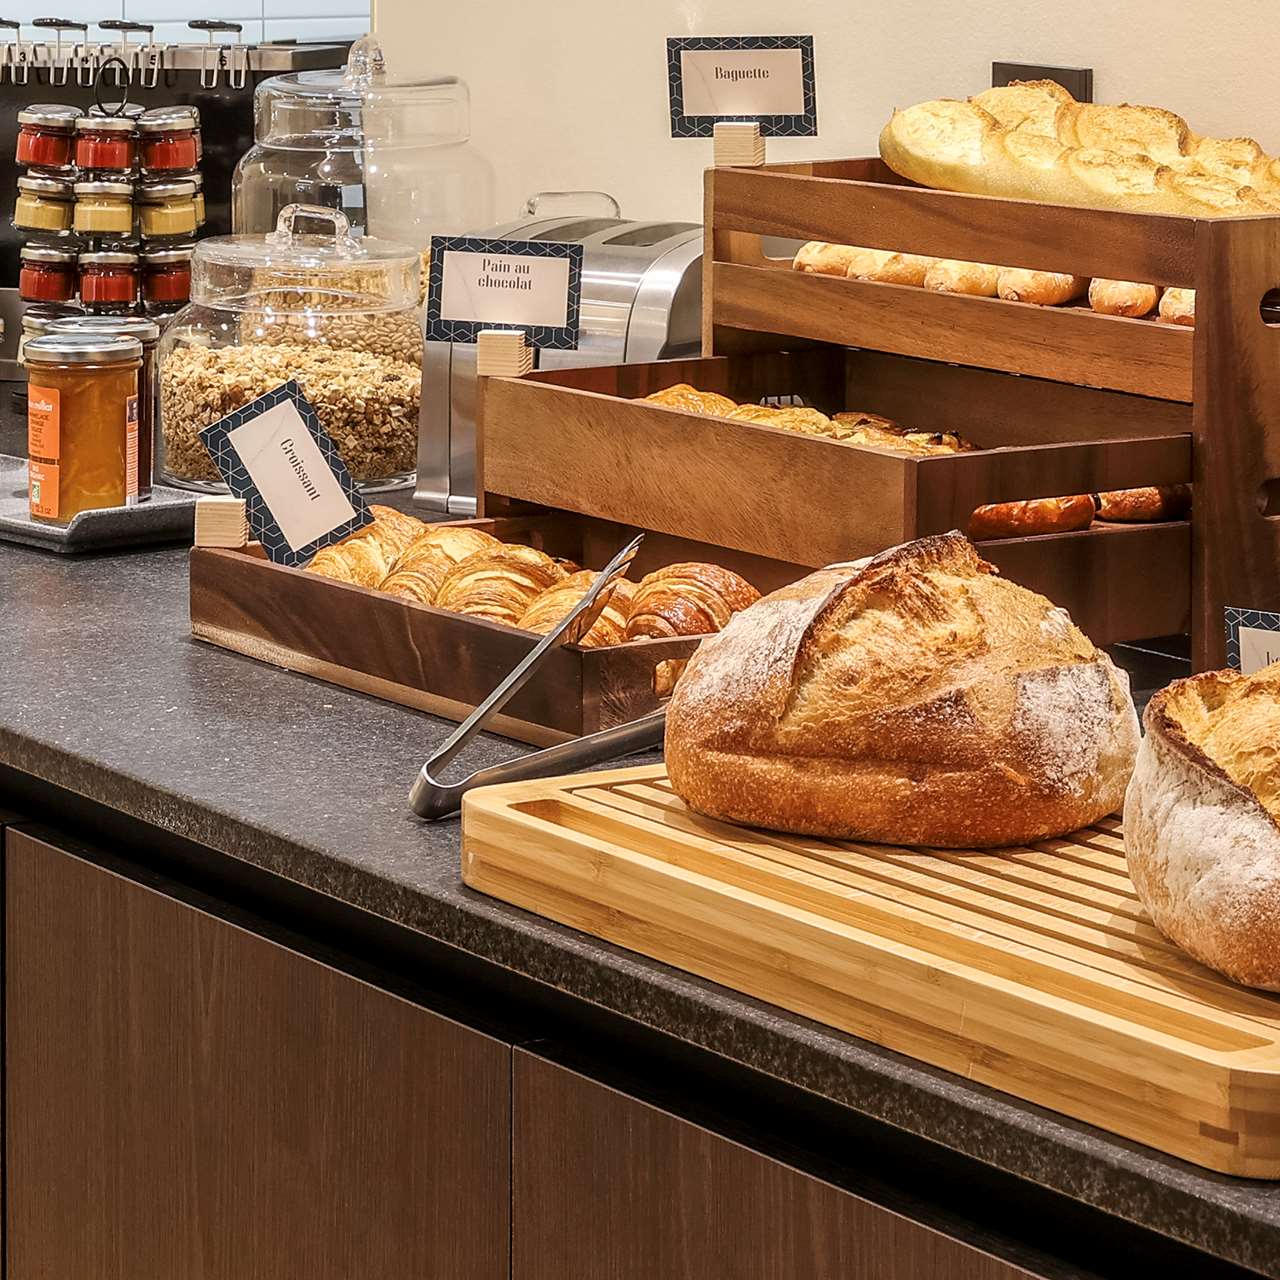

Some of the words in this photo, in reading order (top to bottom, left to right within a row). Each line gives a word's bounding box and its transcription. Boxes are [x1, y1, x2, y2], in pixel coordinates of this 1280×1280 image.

[19, 51, 26, 62] 3
[714, 66, 770, 82] Baguette
[482, 258, 512, 274] Pain
[514, 263, 530, 274] au
[478, 274, 533, 291] chocolat
[280, 438, 321, 501] Croissant
